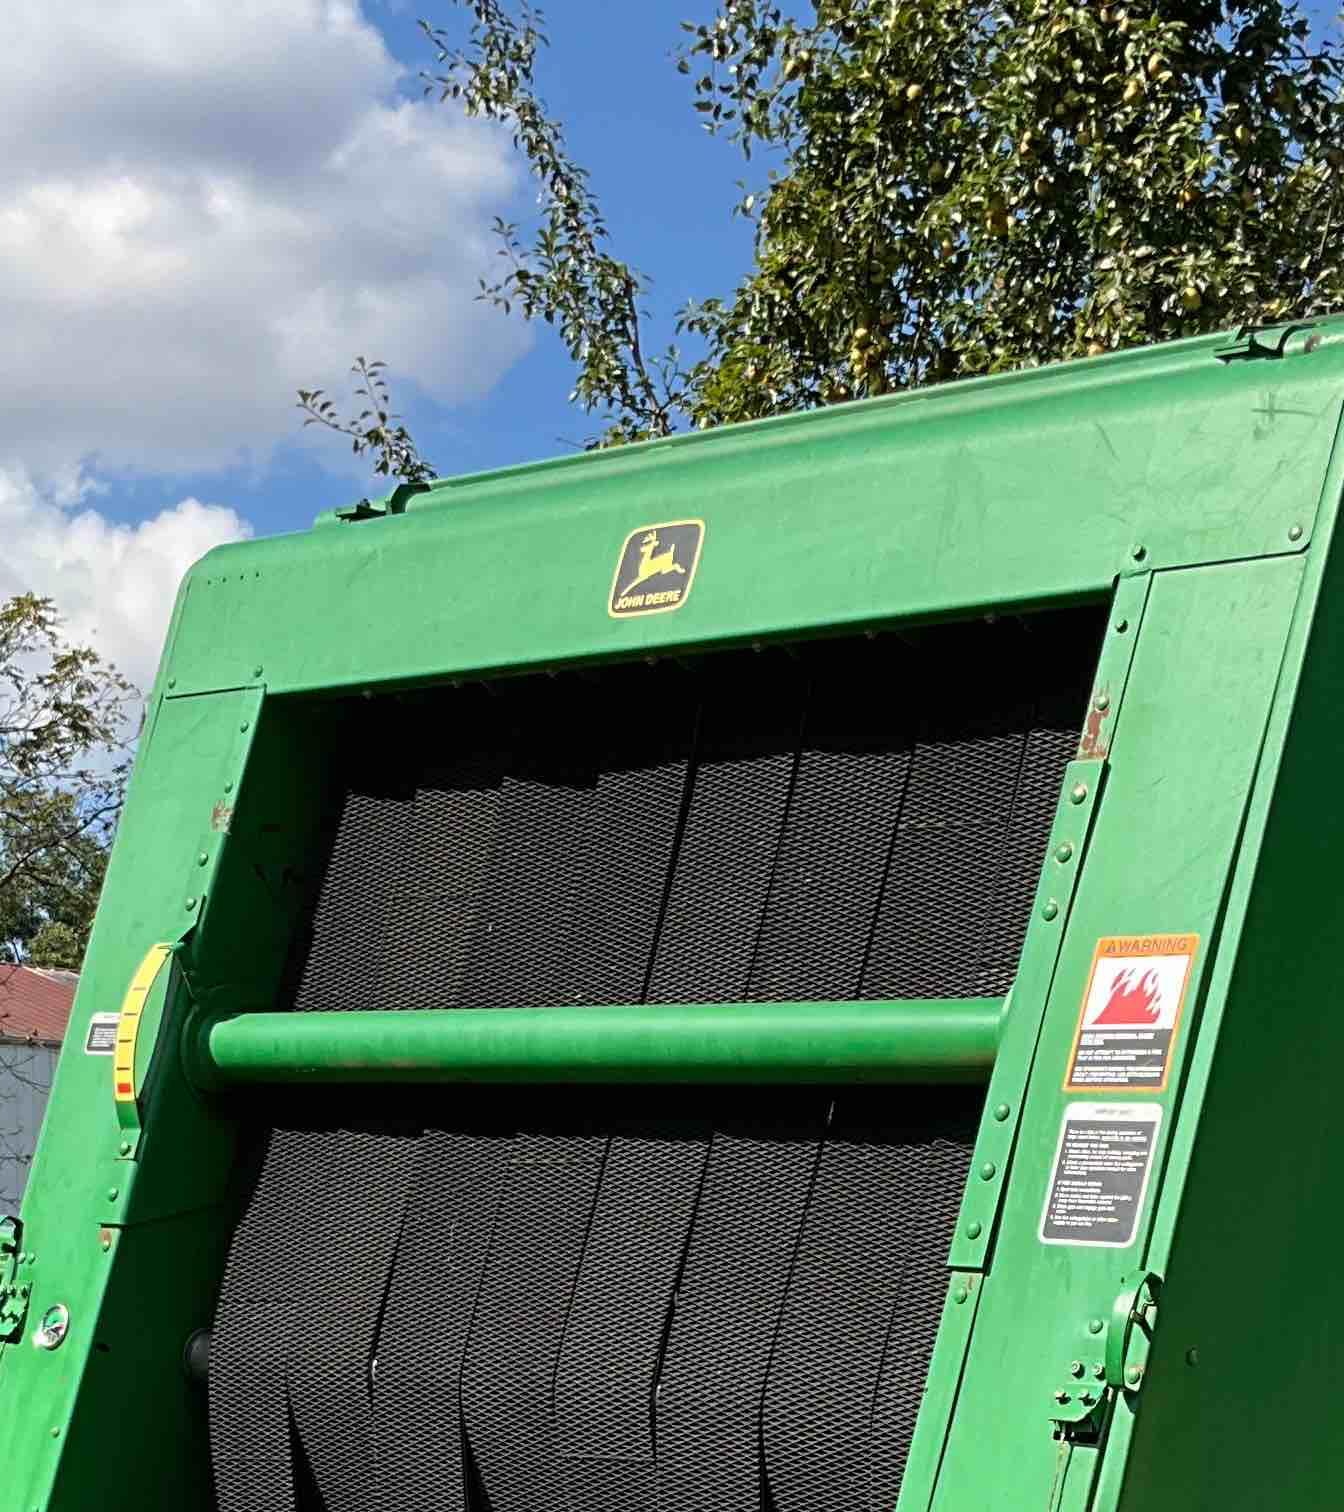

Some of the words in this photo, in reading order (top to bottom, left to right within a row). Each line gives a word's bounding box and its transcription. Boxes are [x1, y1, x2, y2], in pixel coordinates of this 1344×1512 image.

[615, 595, 645, 609] JOHN
[645, 590, 682, 606] DEERE
[1118, 937, 1187, 953] WARNING
